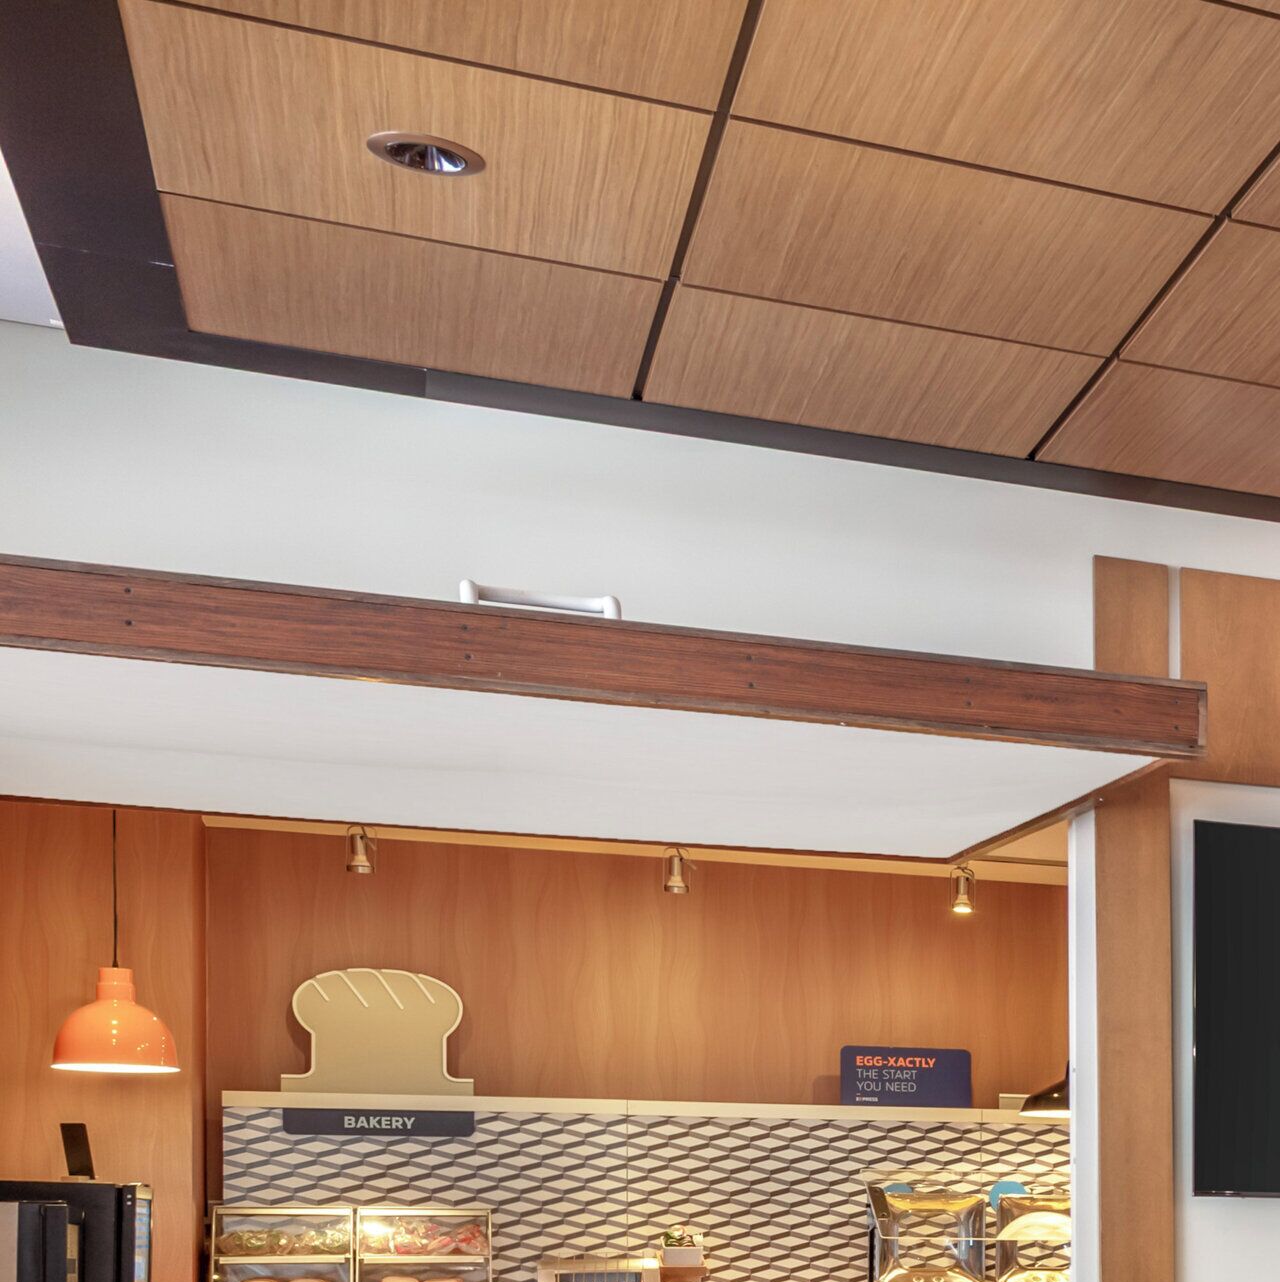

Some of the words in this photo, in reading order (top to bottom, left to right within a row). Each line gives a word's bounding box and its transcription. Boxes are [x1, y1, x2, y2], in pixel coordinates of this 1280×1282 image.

[855, 1055, 937, 1069] EGG-XACTLY
[856, 1068, 879, 1080] THE
[882, 1069, 918, 1081] START
[856, 1081, 882, 1092] YOU
[885, 1082, 917, 1093] NEED
[344, 1116, 416, 1130] BAKERY
